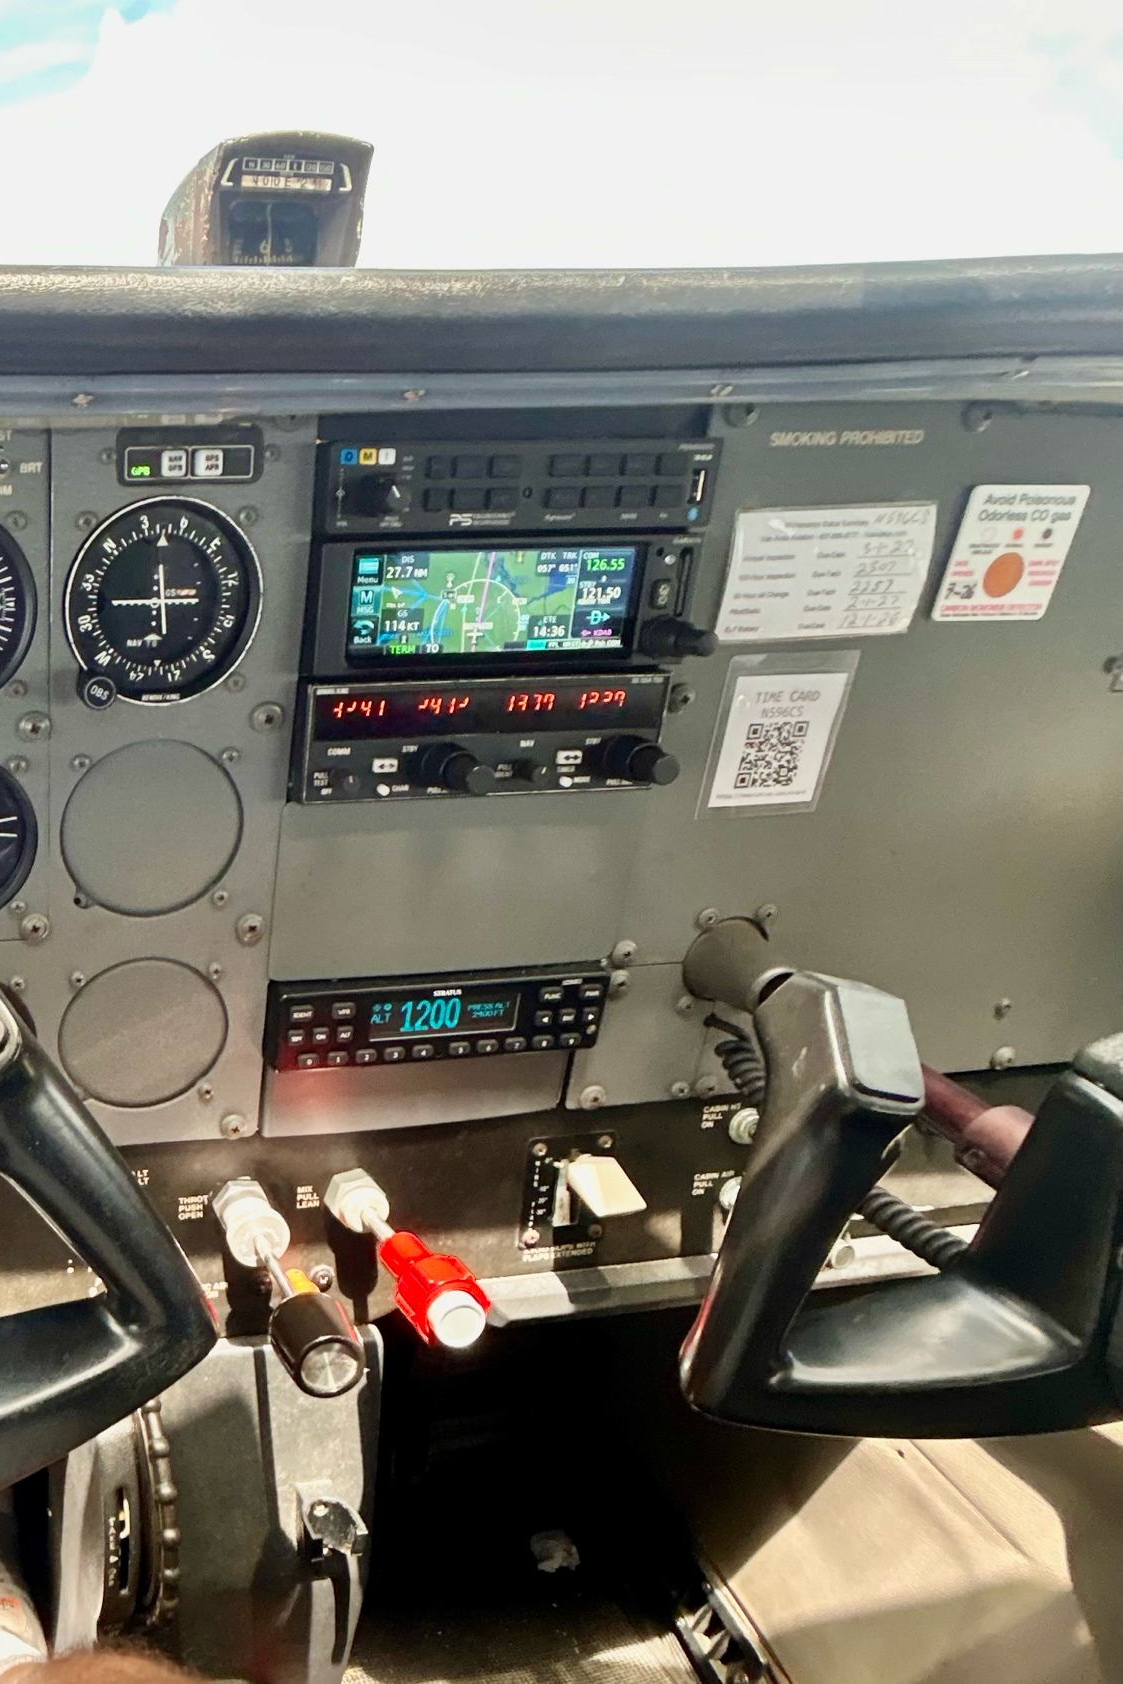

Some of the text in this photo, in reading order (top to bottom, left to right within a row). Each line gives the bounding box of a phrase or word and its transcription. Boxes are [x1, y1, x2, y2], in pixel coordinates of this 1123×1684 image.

[770, 430, 924, 446] SMOKING PROHIBITED
[20, 462, 43, 473] BRT
[131, 466, 151, 476] GPS
[984, 494, 1077, 505] Avoid Poisonous
[978, 510, 1071, 523] Odorless CO gas
[401, 556, 415, 564] DIS
[540, 552, 577, 560] DTK TRK
[586, 559, 625, 571] 126.55
[579, 581, 597, 589] STBY
[583, 587, 621, 599] 121.50
[356, 606, 374, 615] MSG
[533, 626, 565, 637] 14:36
[353, 635, 372, 643] Back
[389, 645, 416, 655] TERM
[90, 685, 109, 701] OBS
[756, 690, 820, 703] TIME CARD
[760, 706, 805, 719] N596CS
[327, 747, 351, 756] COMM
[433, 989, 462, 997] STRATUS
[371, 1013, 392, 1024] ALT
[399, 997, 462, 1033] 1200
[703, 1103, 741, 1113] CABIN HT
[702, 1112, 723, 1121] PULL
[701, 1120, 715, 1129] ON
[694, 1170, 735, 1181] CABIN AIR
[693, 1180, 714, 1188] PULL
[297, 1186, 313, 1194] MIX
[691, 1188, 705, 1196] ON
[178, 1195, 209, 1206] THROT
[297, 1193, 319, 1201] PULL
[178, 1203, 203, 1212] PUSH
[296, 1201, 320, 1209] LEAN
[178, 1211, 204, 1220] OPEN
[551, 1248, 594, 1260] EXTENDED
